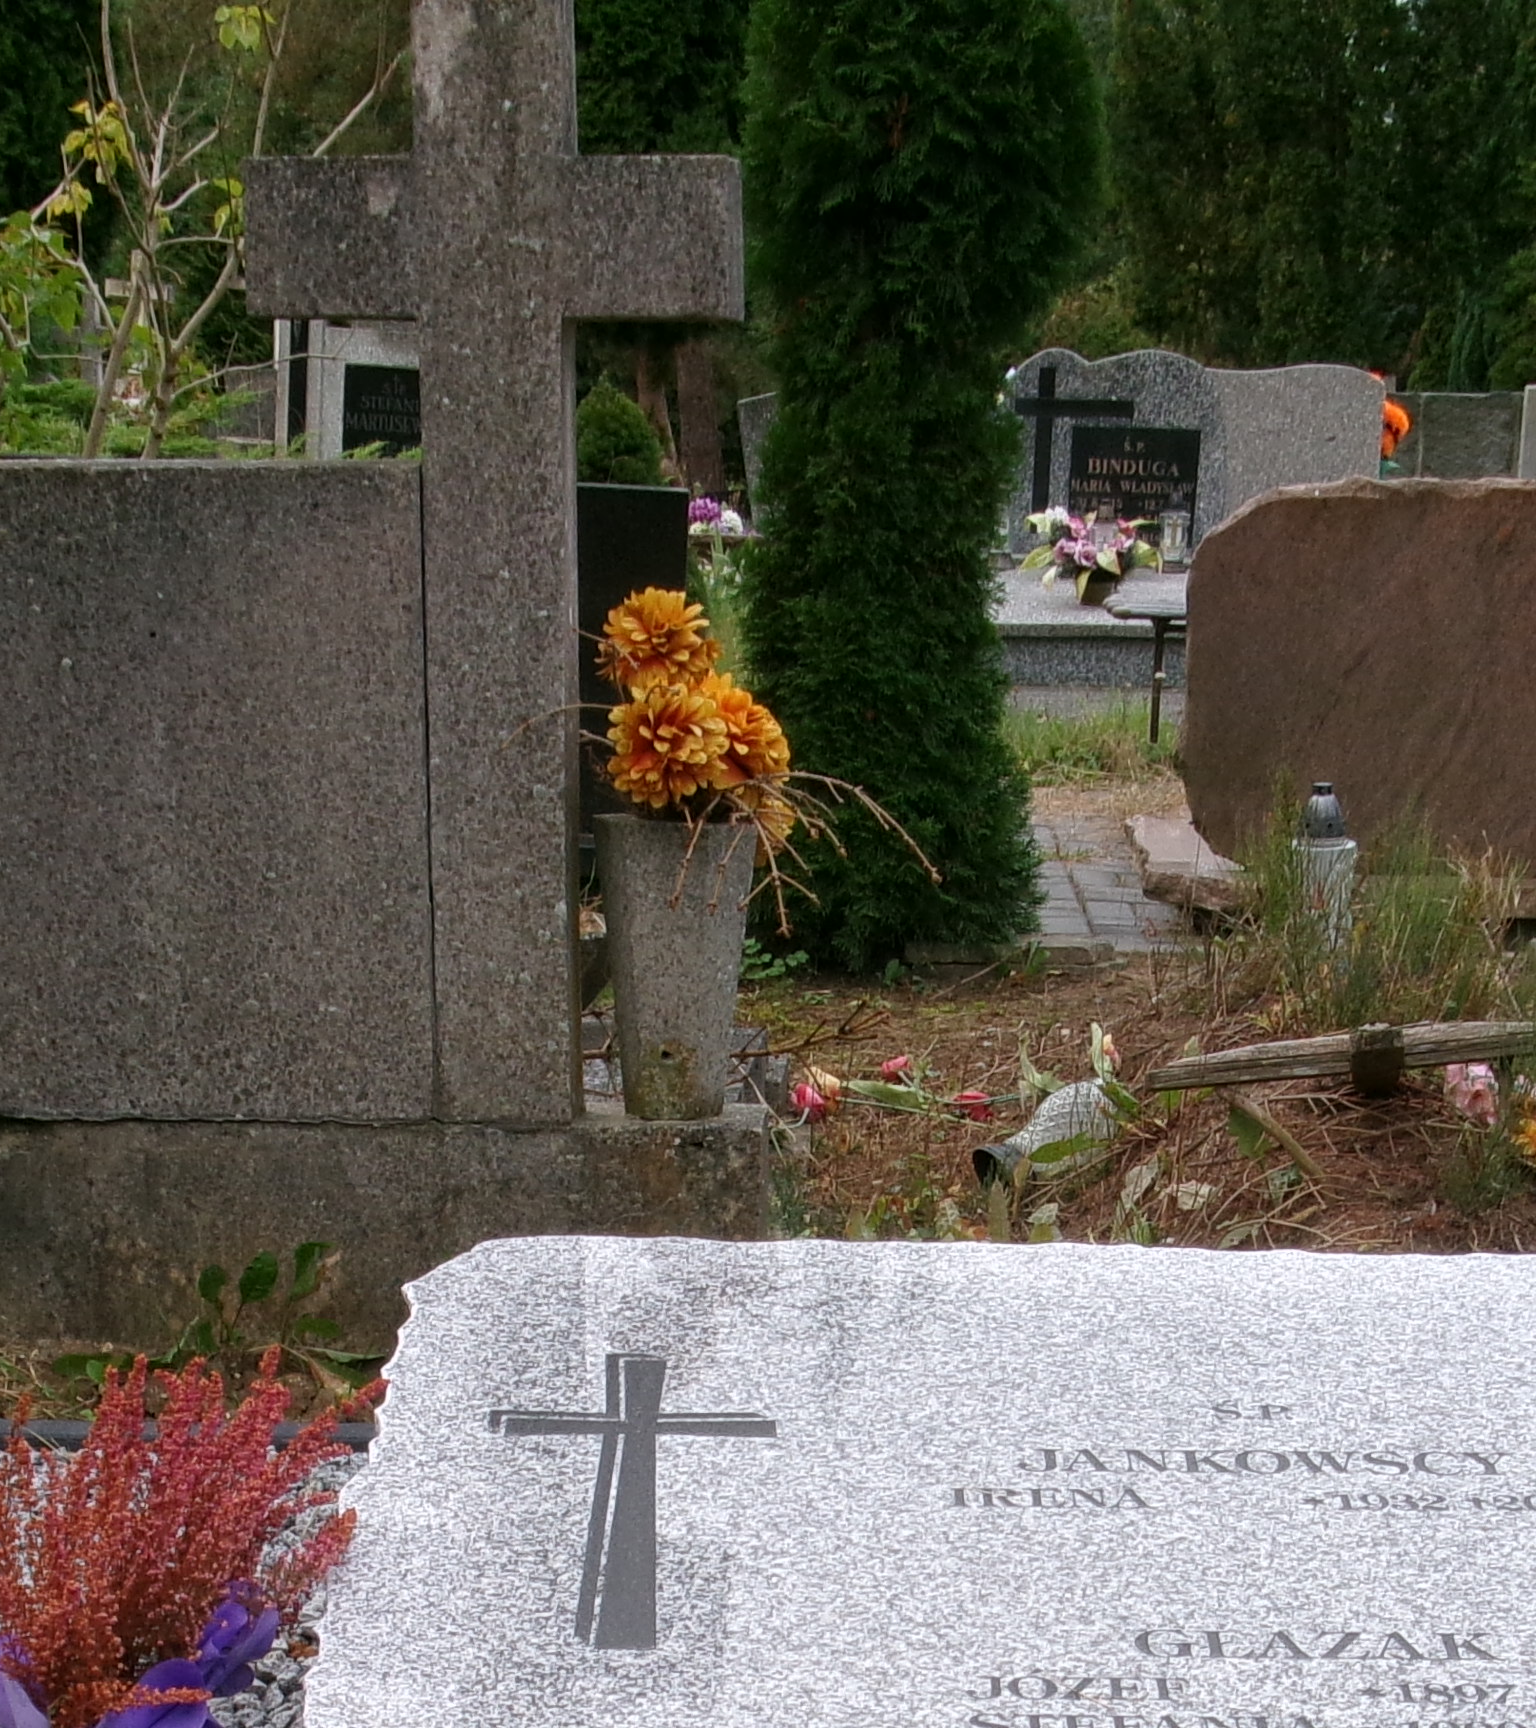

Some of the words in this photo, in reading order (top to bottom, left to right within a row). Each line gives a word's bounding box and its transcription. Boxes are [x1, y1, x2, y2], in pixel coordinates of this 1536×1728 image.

[1087, 457, 1180, 477] BINDUGA
[1071, 479, 1112, 493] MARIA
[1016, 1448, 1512, 1476] JANKOWSCY
[951, 1486, 1154, 1509] IRENA
[964, 1668, 1190, 1702] JÓZEF
